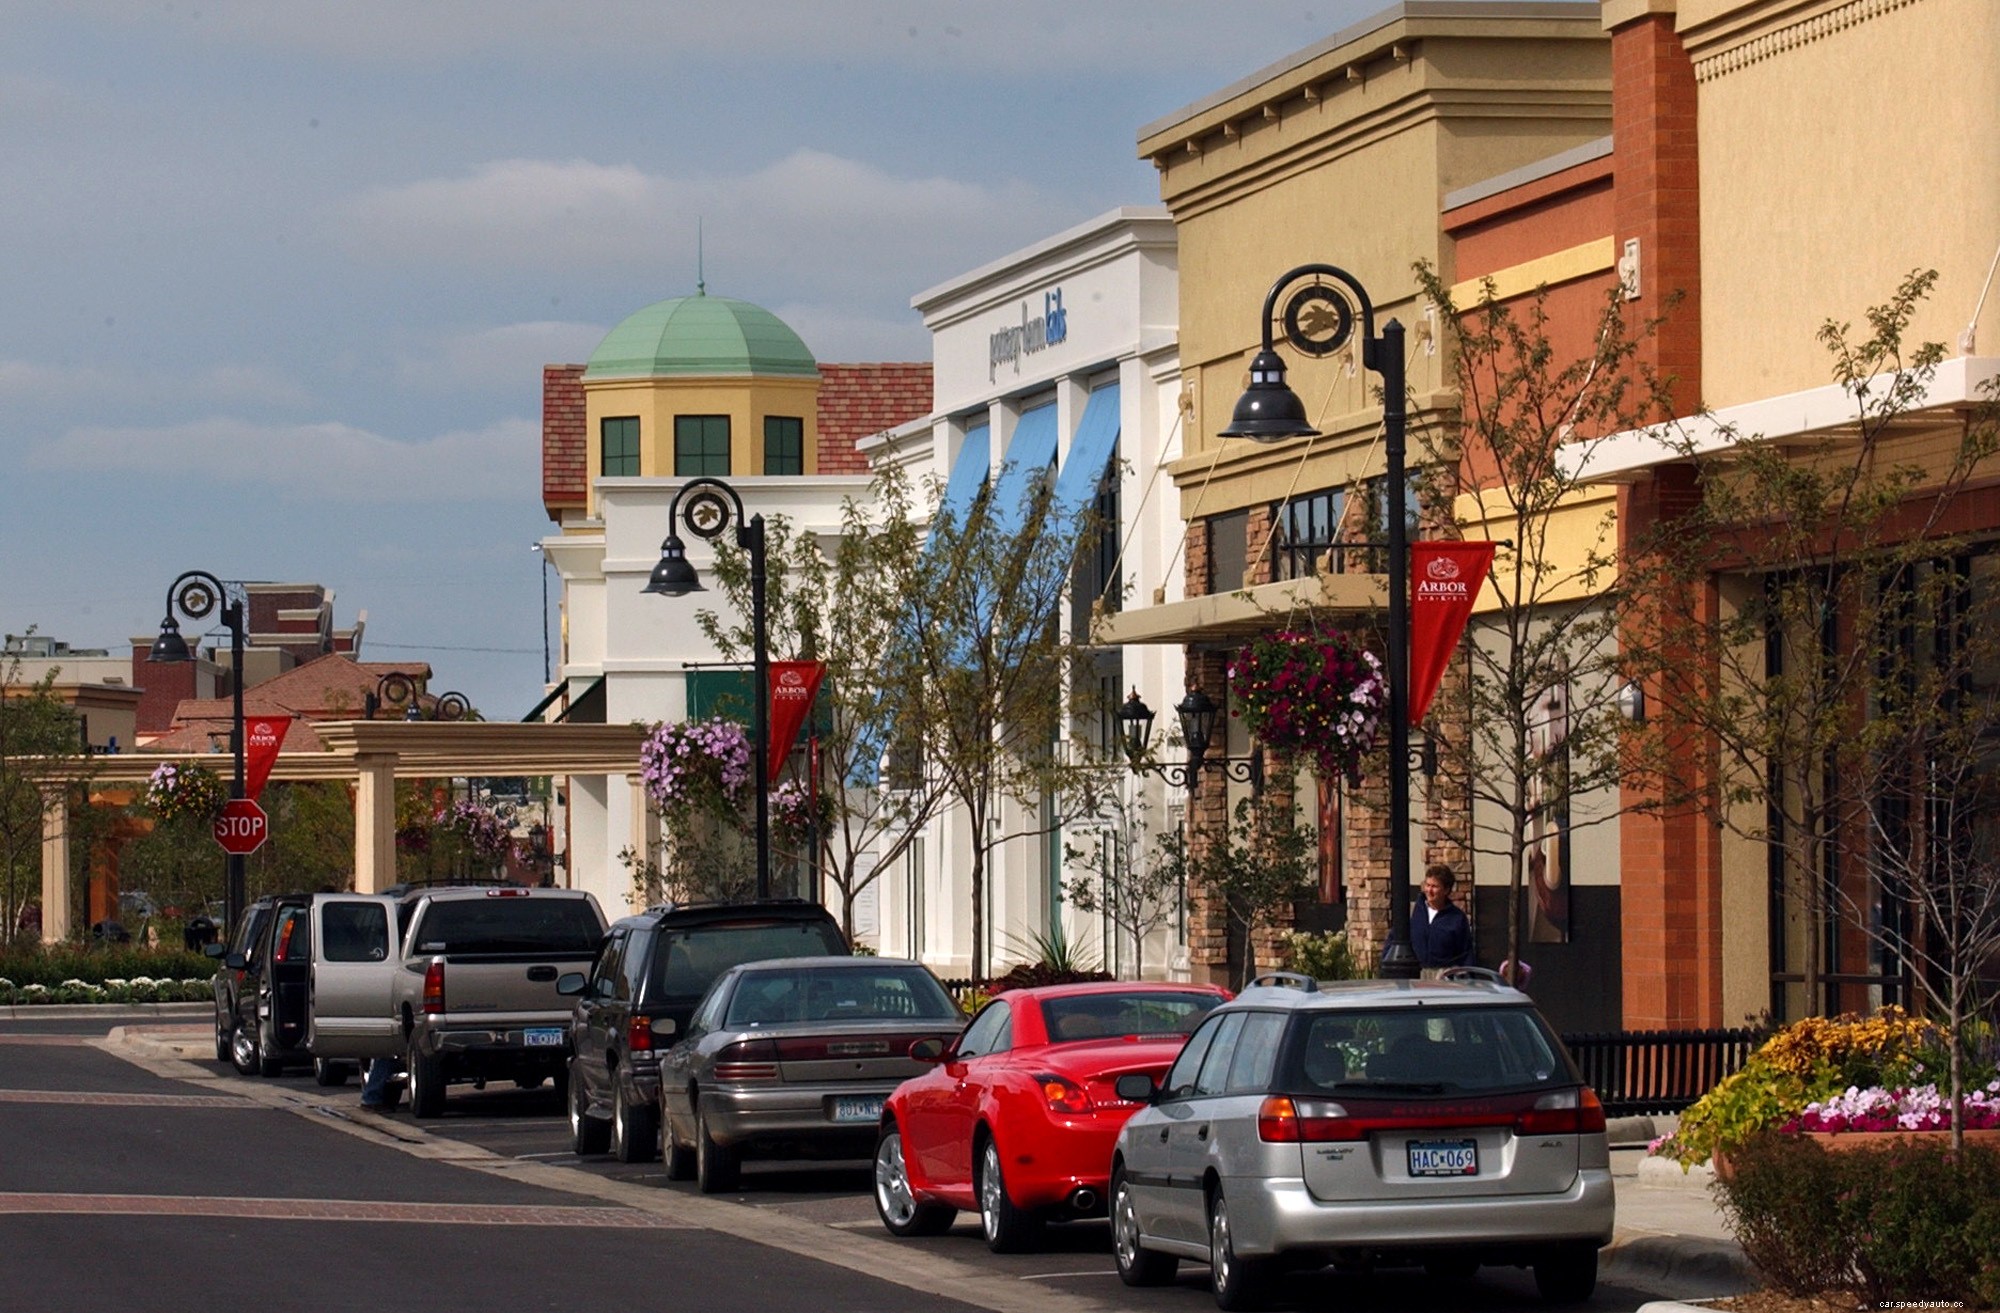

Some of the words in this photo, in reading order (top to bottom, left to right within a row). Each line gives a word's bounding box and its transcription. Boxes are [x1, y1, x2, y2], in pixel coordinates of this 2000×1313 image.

[1045, 286, 1067, 347] kids
[1418, 580, 1467, 592] ARBOR
[216, 816, 263, 837] STOP
[1412, 1151, 1440, 1169] HAC
[1446, 1150, 1473, 1167] 069
